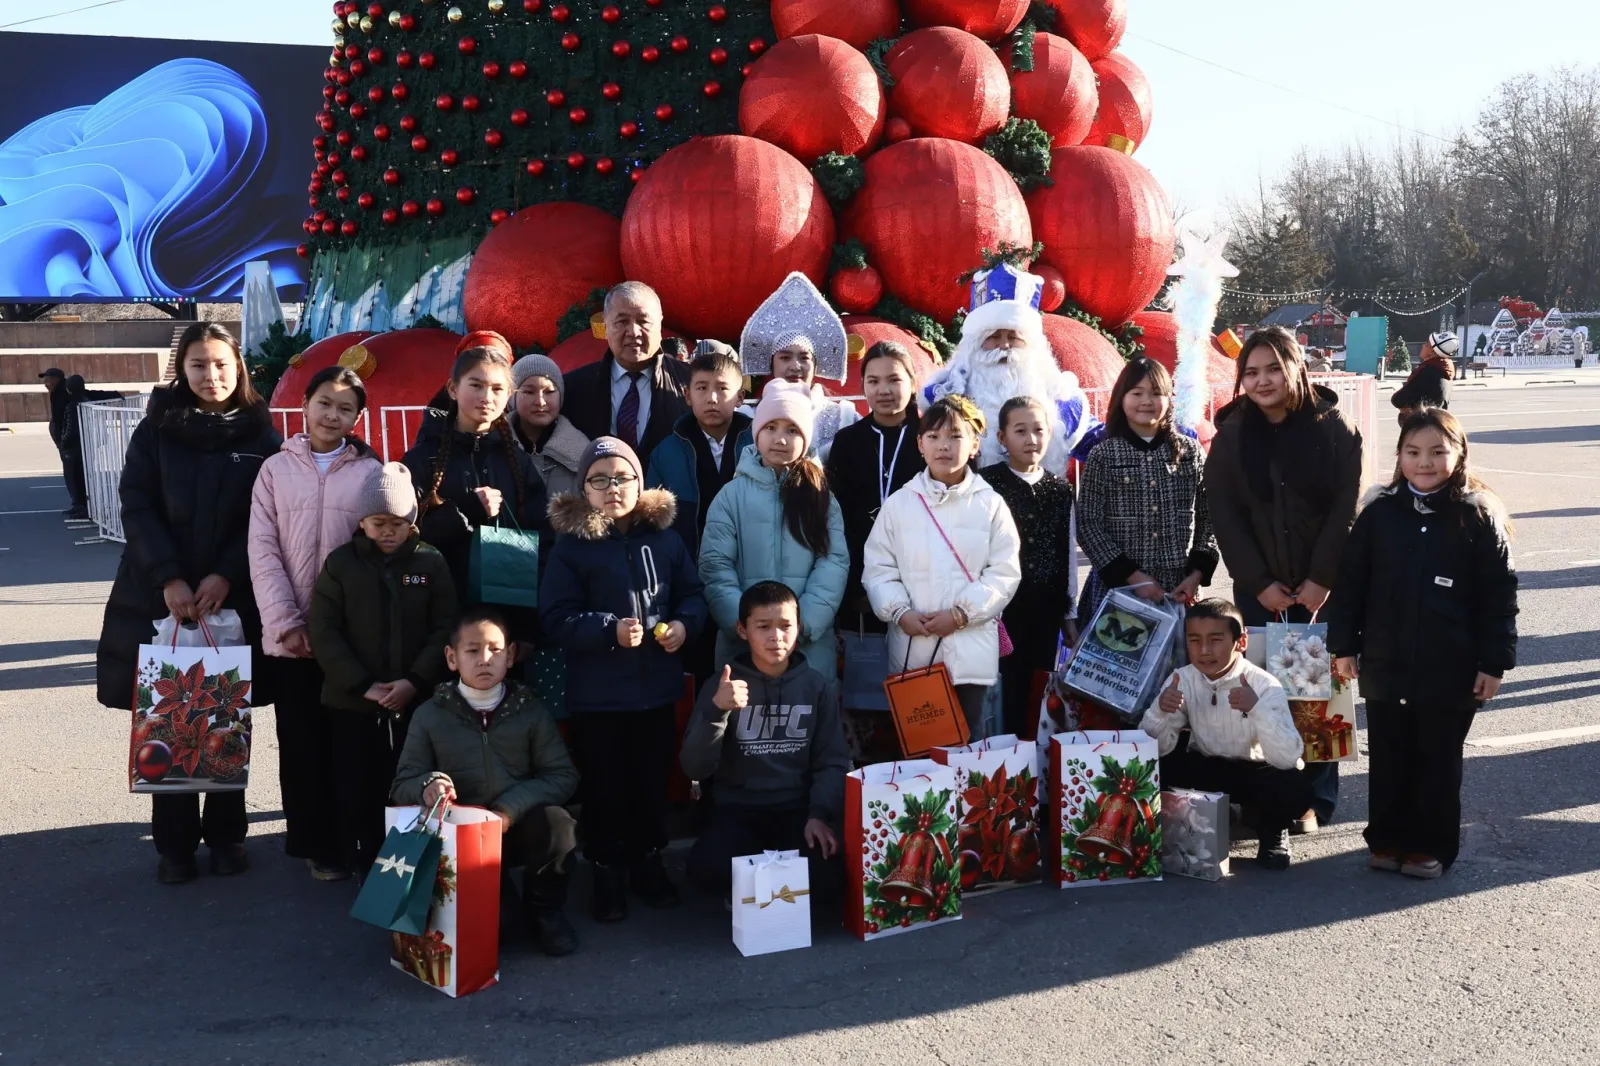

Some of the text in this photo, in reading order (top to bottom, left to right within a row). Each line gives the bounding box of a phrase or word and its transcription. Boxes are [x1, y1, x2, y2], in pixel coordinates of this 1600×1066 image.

[1082, 640, 1141, 671] MORRISONS
[1083, 669, 1095, 680] at
[1094, 674, 1140, 699] Morrisons
[1092, 660, 1128, 683] reasons
[1128, 676, 1140, 688] to
[735, 704, 813, 740] UFC
